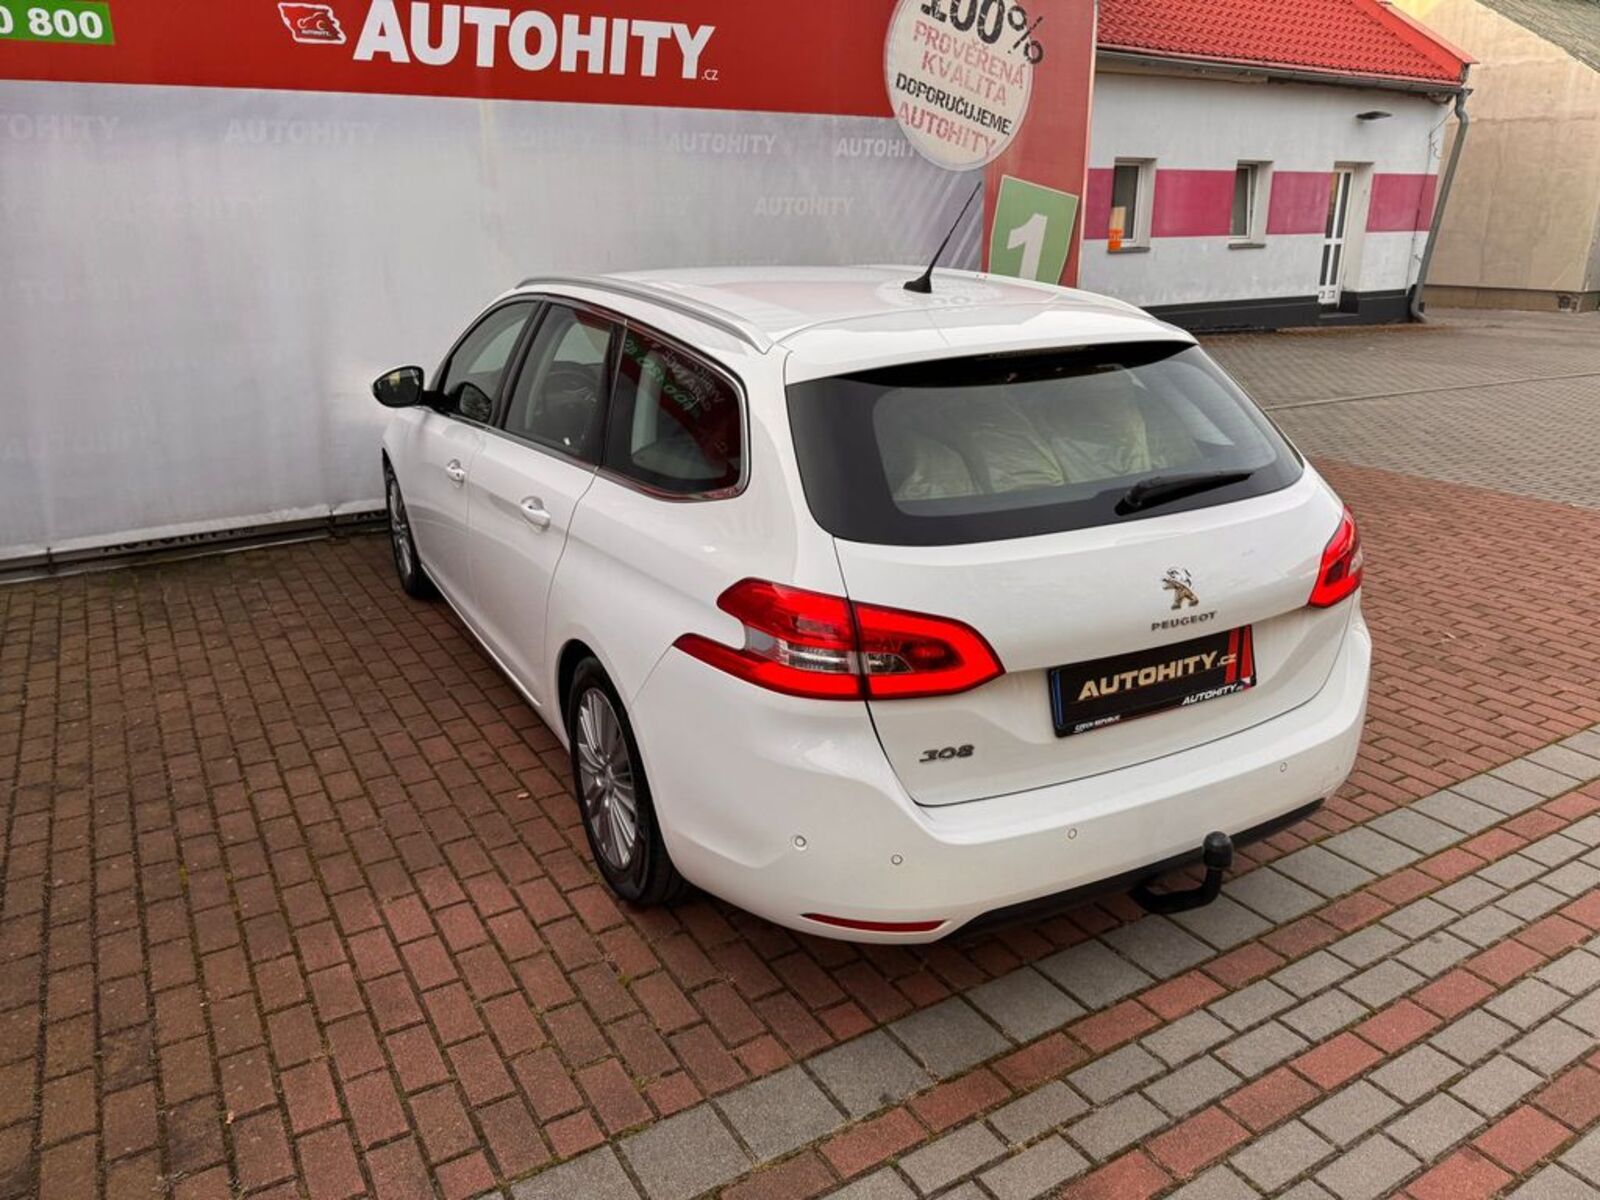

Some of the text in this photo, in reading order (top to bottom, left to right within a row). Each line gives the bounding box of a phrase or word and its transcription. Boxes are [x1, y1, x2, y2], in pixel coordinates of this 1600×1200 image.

[27, 7, 103, 38] 800
[913, 18, 1025, 88] PROVĚŘENÁ
[921, 51, 1007, 106] KVALITA
[896, 73, 1012, 136] DOPORUČUJEME
[224, 116, 379, 145] AUTOHITY
[668, 133, 776, 156] AUTOHITY
[900, 101, 997, 158] AUTOHITY
[753, 197, 854, 216] AUTOHITY
[1006, 212, 1048, 281] 1
[1151, 610, 1218, 631] PEUGEOT
[919, 744, 975, 762] 308
